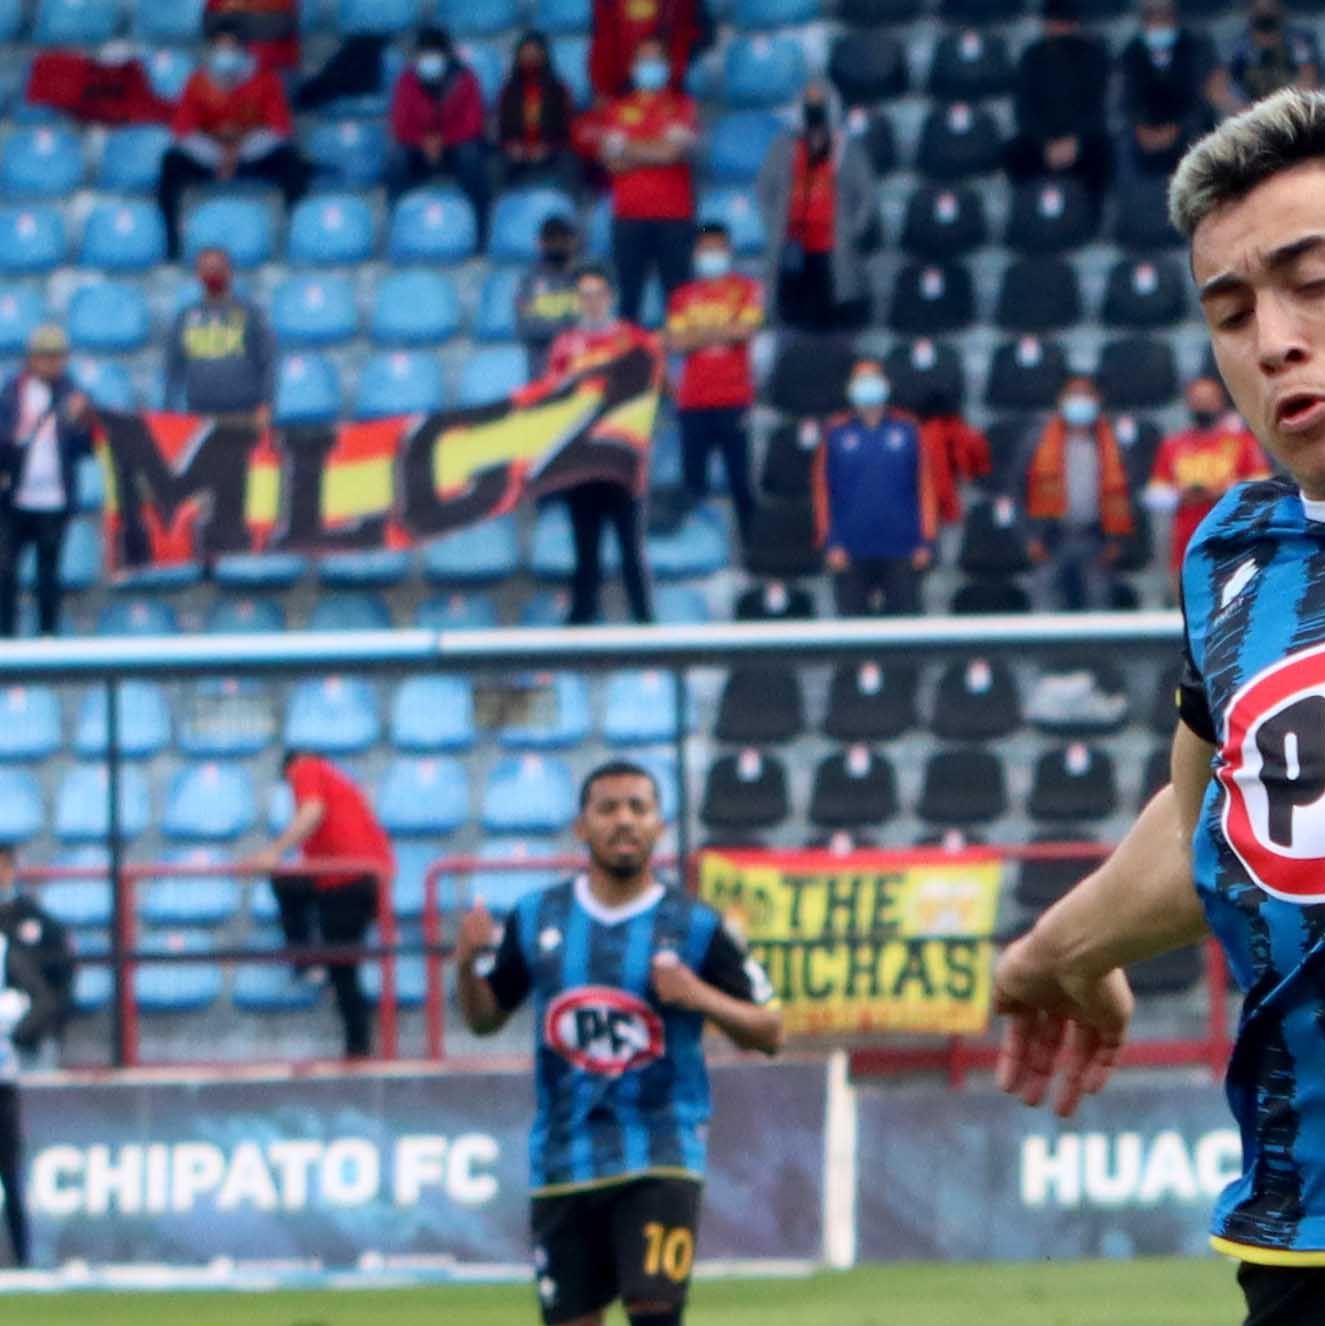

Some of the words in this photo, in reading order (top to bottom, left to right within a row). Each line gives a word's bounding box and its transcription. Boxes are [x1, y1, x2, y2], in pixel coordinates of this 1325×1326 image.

[781, 873, 903, 937] THE
[573, 1008, 636, 1053] PF
[30, 1135, 382, 1216] CHIPATO
[393, 1130, 501, 1206] FC
[1021, 1128, 1244, 1204] HUAC
[642, 1220, 695, 1282] 10
